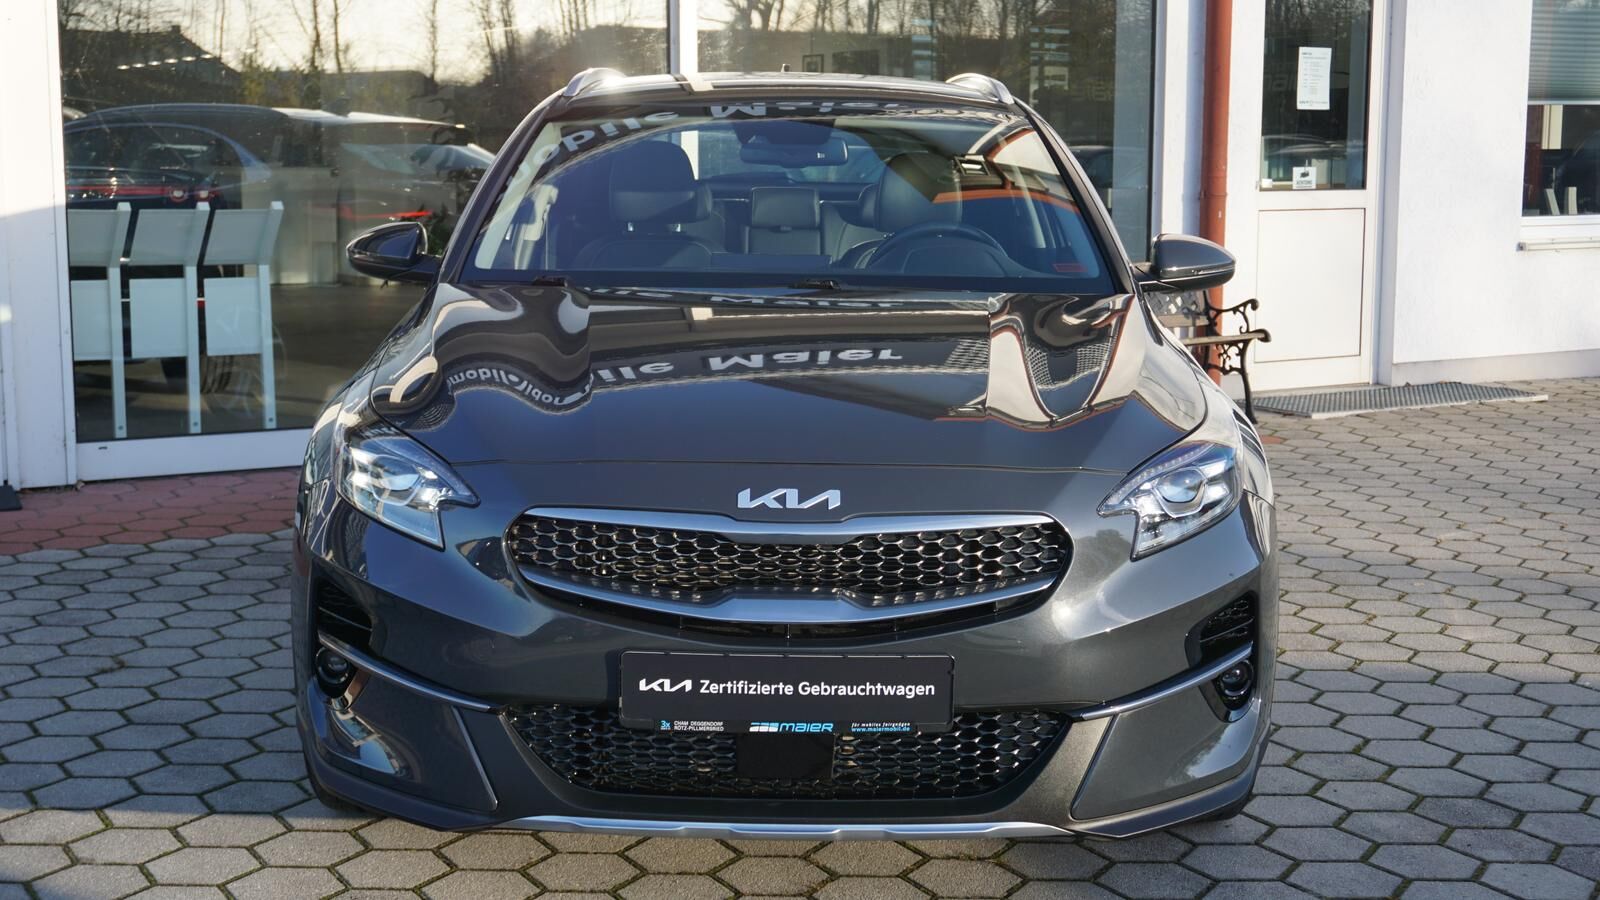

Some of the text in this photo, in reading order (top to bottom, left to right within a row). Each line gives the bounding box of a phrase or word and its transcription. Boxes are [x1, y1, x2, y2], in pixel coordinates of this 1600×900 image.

[738, 488, 840, 510] KIA
[639, 678, 934, 698] KIA Zertifizierte Gebrauchtwagen
